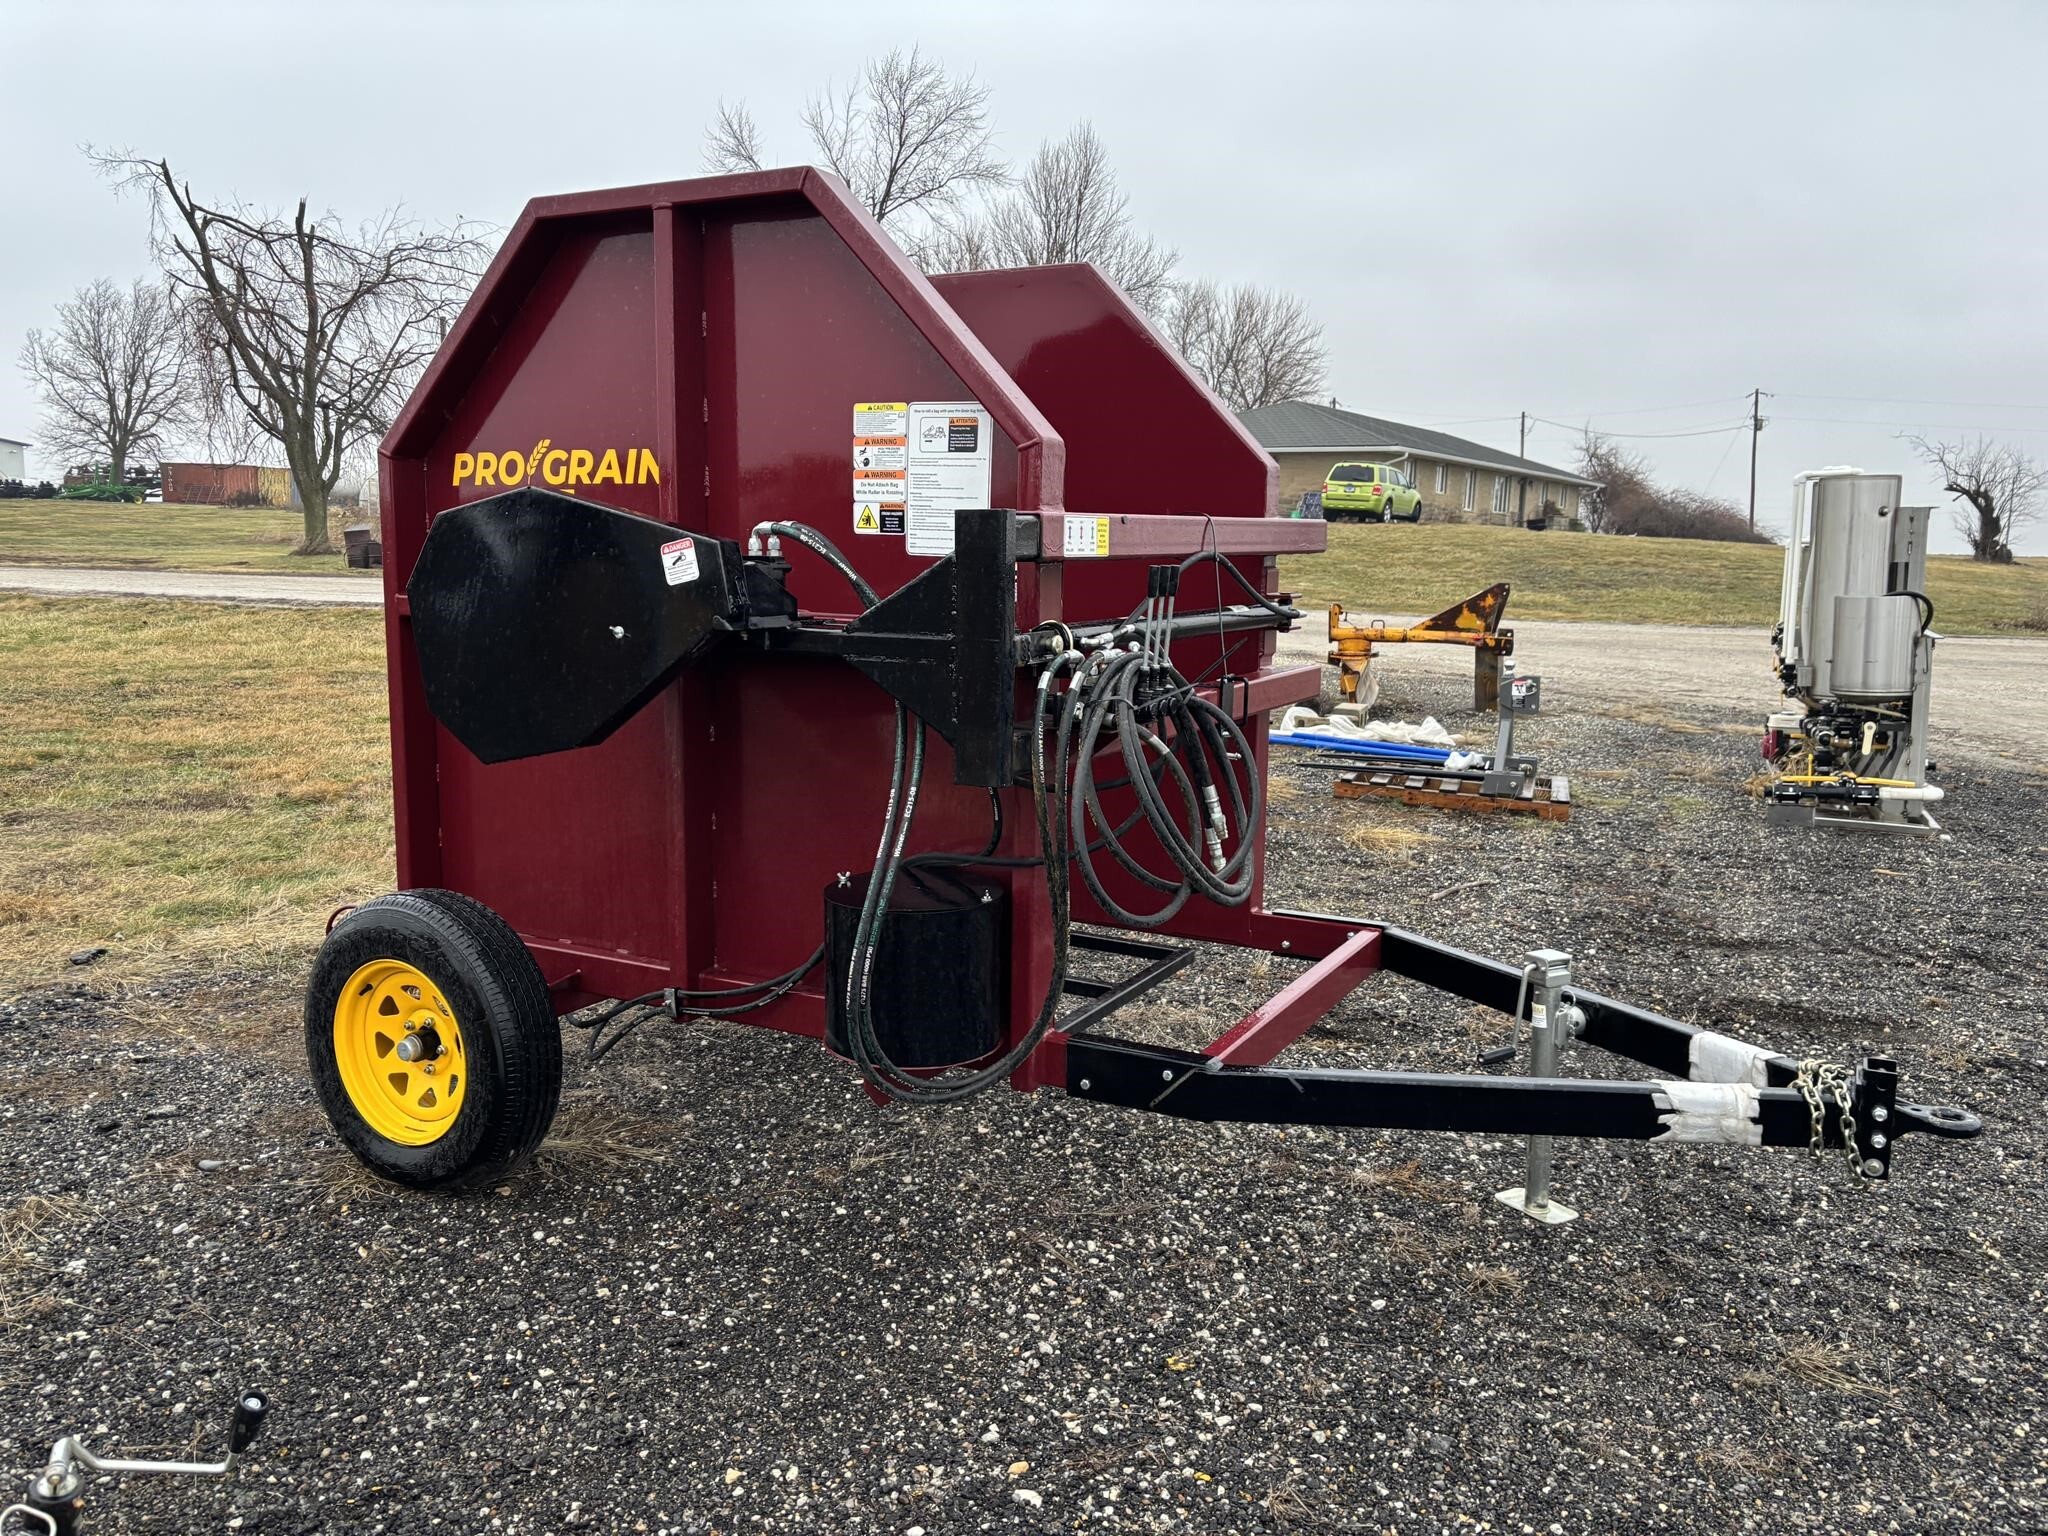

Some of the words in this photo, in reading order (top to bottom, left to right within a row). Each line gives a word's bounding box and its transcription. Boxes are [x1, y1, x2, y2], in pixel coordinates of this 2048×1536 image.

[452, 450, 526, 486] PRO
[542, 448, 660, 485] GRAIN
[669, 541, 692, 552] DANGER
[838, 561, 858, 581] Winner
[894, 833, 905, 857] Winner
[904, 786, 917, 818] EC215-08
